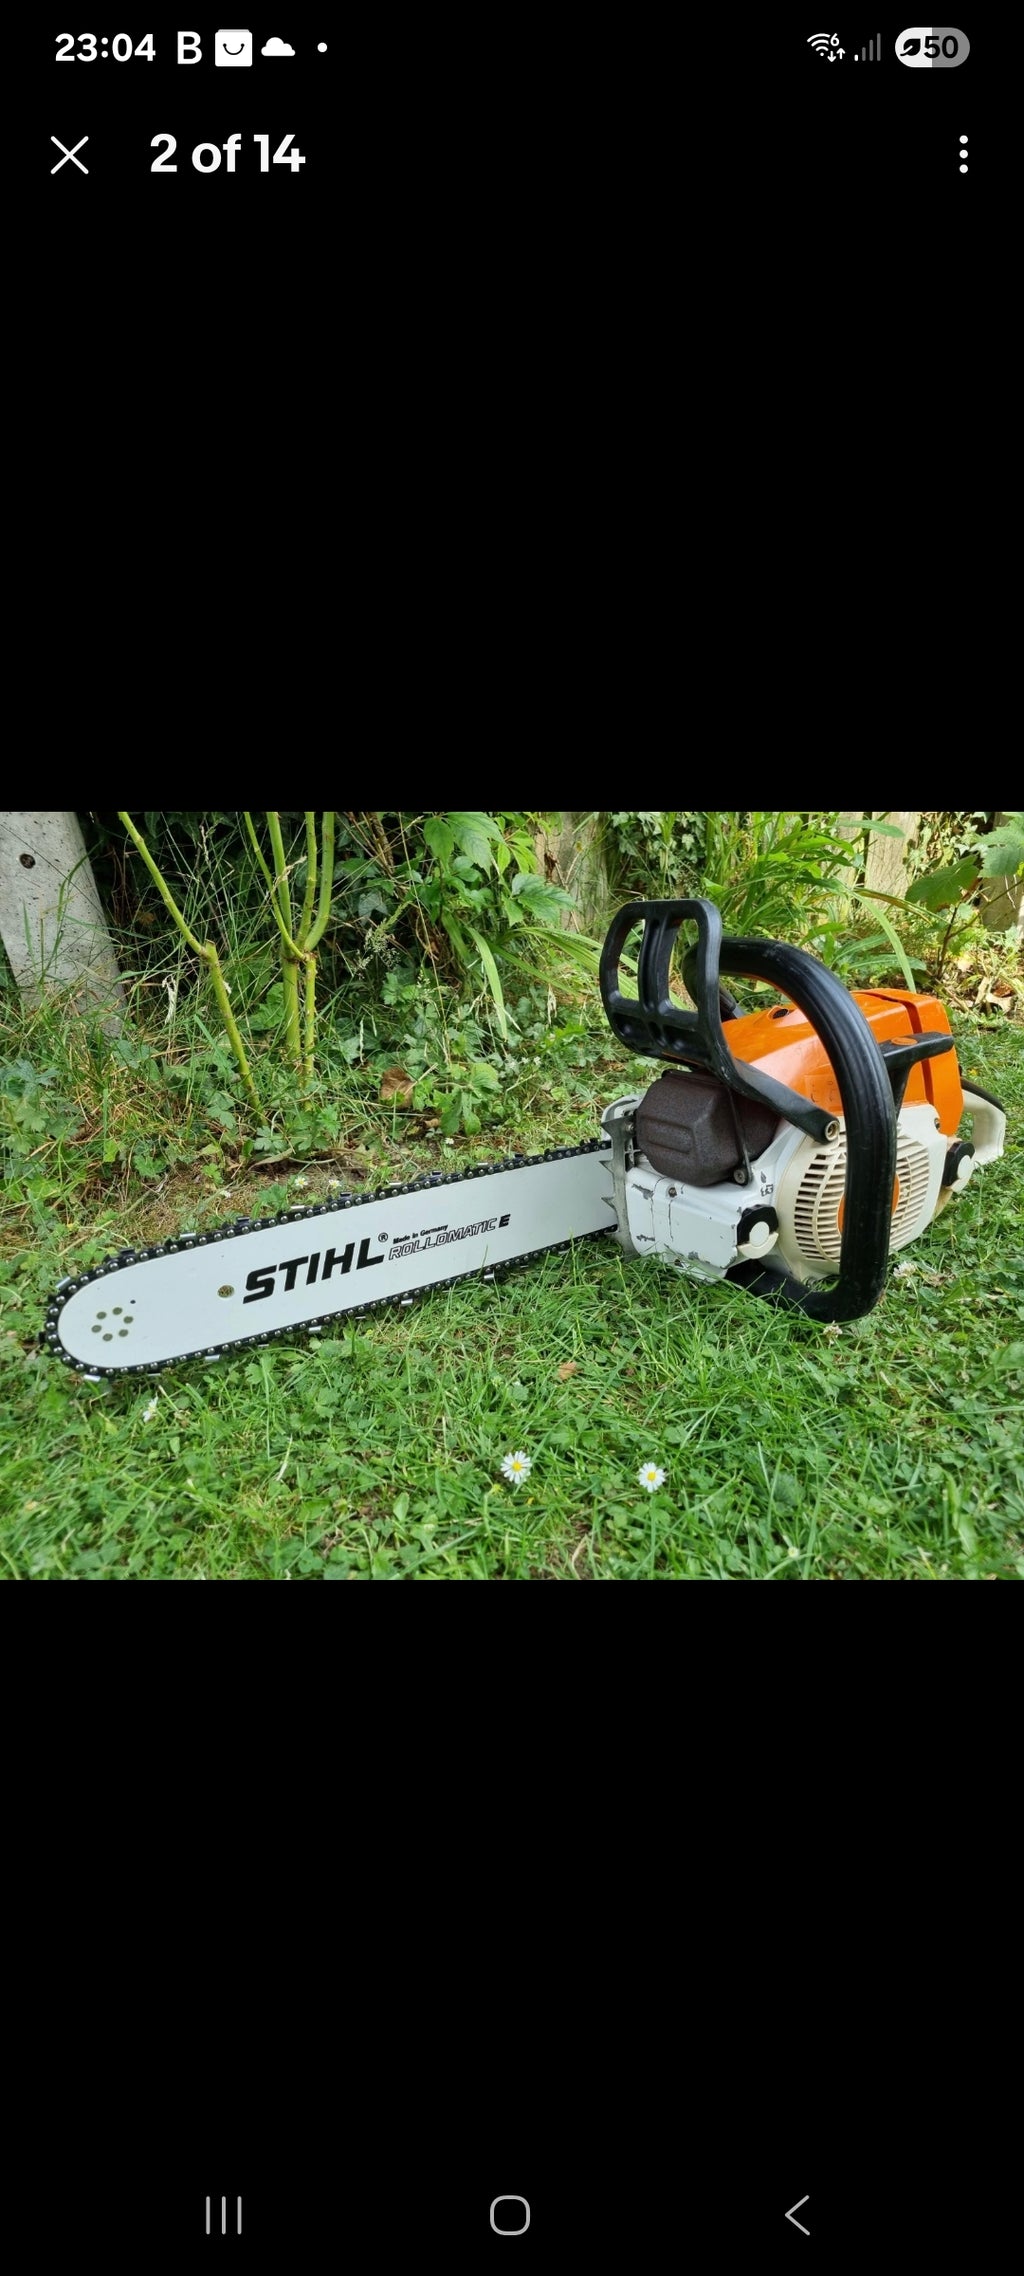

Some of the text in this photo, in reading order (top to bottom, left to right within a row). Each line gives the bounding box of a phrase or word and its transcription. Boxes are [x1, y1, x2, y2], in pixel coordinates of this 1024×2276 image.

[55, 33, 156, 62] 23:04
[178, 31, 202, 65] B
[831, 33, 840, 47] 6
[923, 35, 959, 59] 50
[151, 134, 306, 174] 2 of 14
[388, 1213, 511, 1261] ROLLOMATIC E
[393, 1234, 410, 1244] Made
[420, 1224, 449, 1237] Germany
